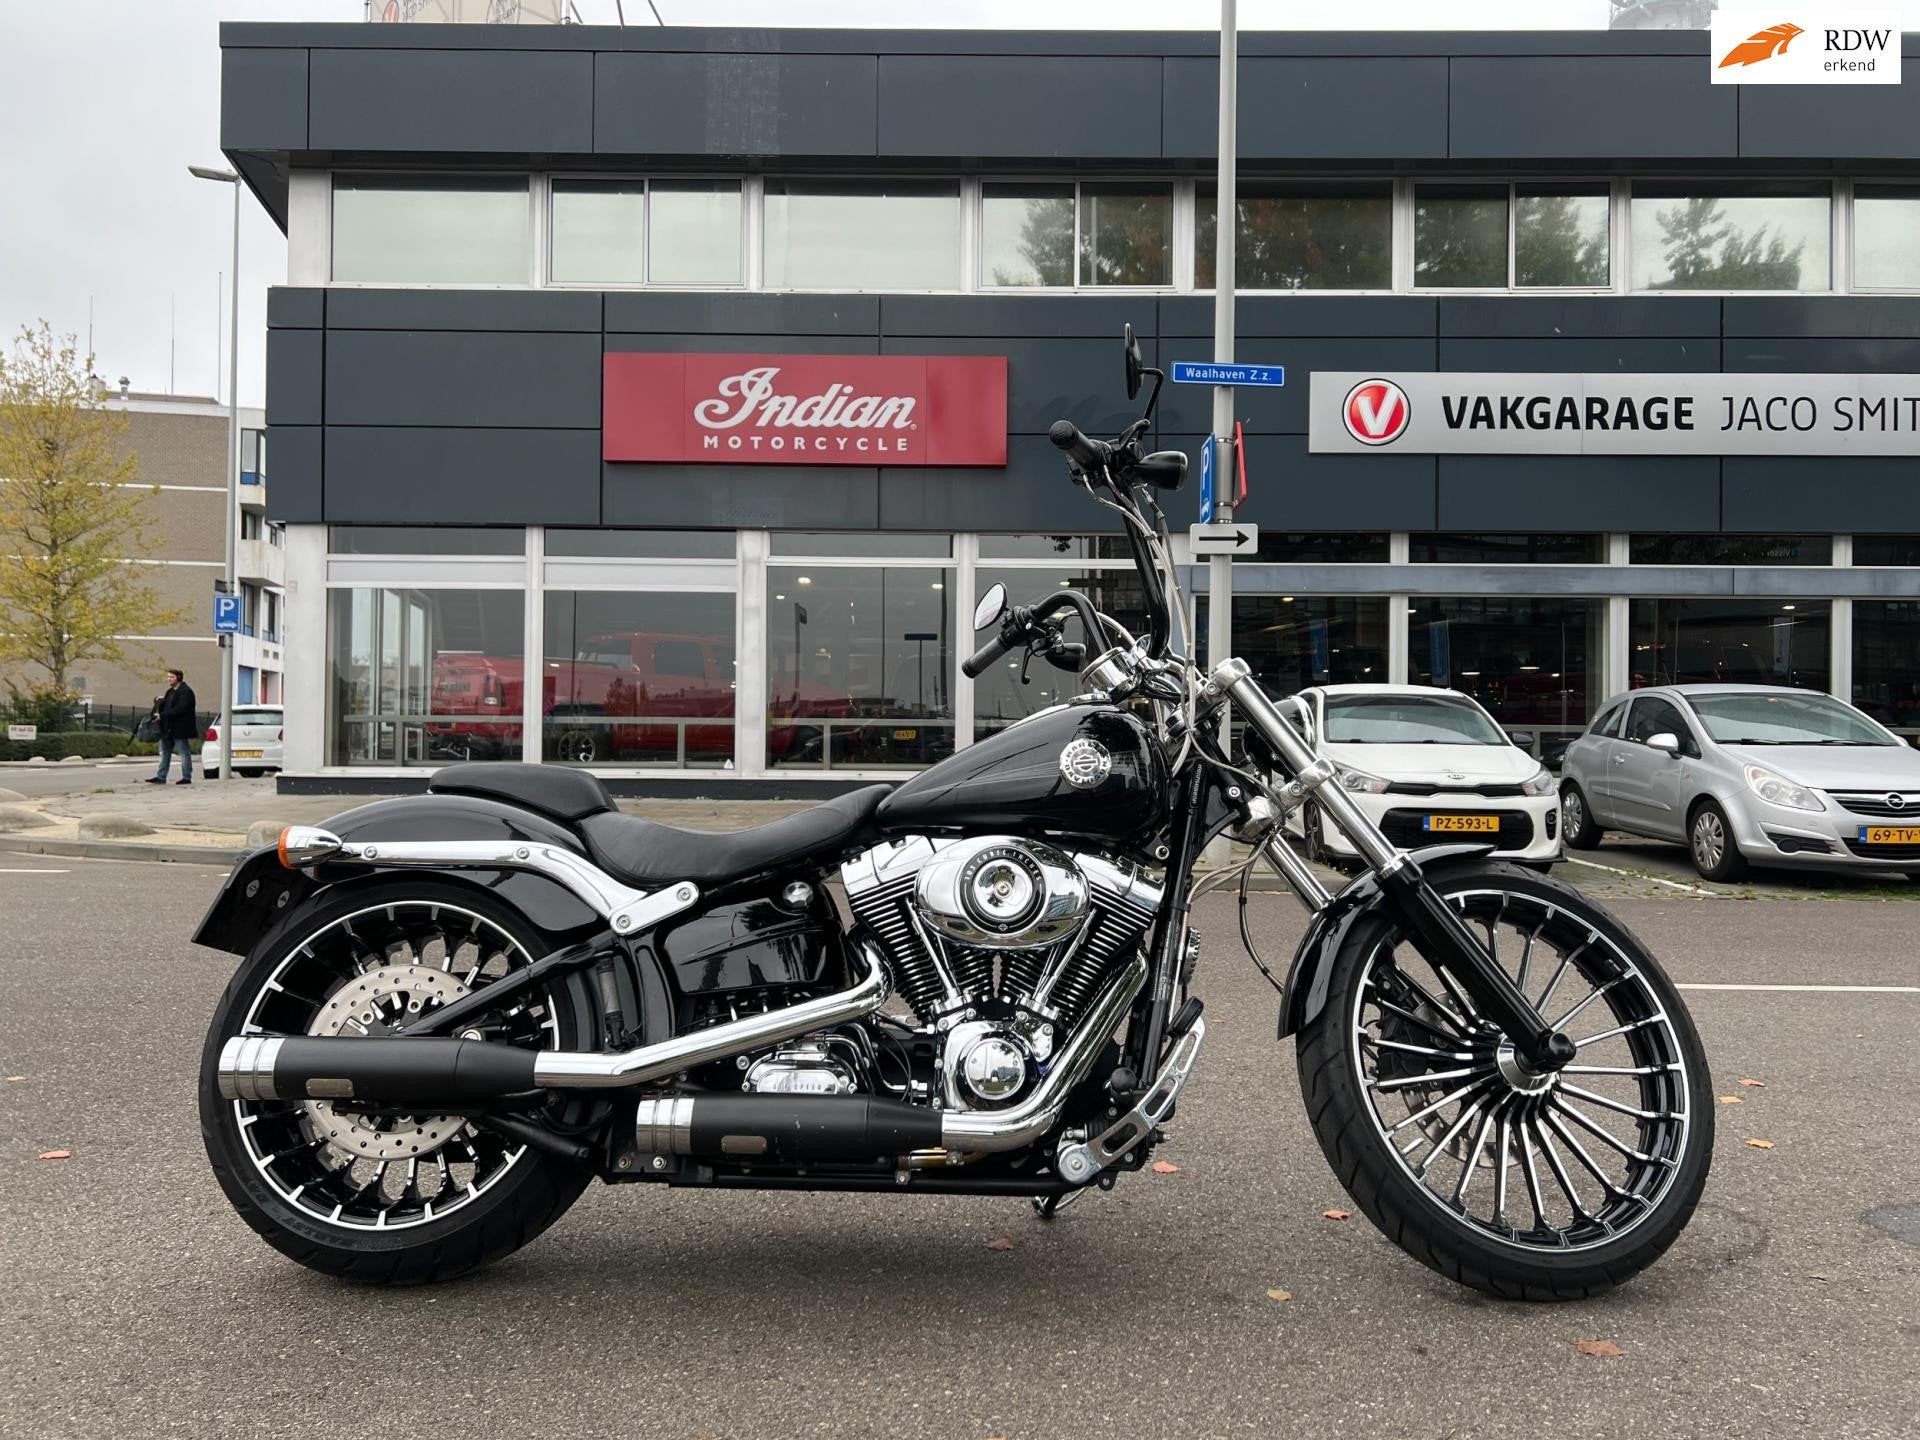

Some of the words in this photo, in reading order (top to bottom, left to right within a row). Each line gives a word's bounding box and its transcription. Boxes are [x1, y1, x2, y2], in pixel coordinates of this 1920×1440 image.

[1185, 367, 1245, 380] Waalhaven
[1250, 370, 1272, 381] Z.z.
[694, 366, 916, 429] Indian
[1442, 396, 1695, 431] VAKGARAGE
[1721, 396, 1817, 431] JACO
[1833, 397, 1920, 431] SMIT
[703, 435, 908, 451] MOTORCYCLE
[220, 599, 235, 617] P
[1436, 817, 1493, 830] PZ-593-L
[1873, 829, 1920, 841] 69-TV-
[977, 849, 1007, 864] CUBIC
[1013, 851, 1042, 881] INCHES
